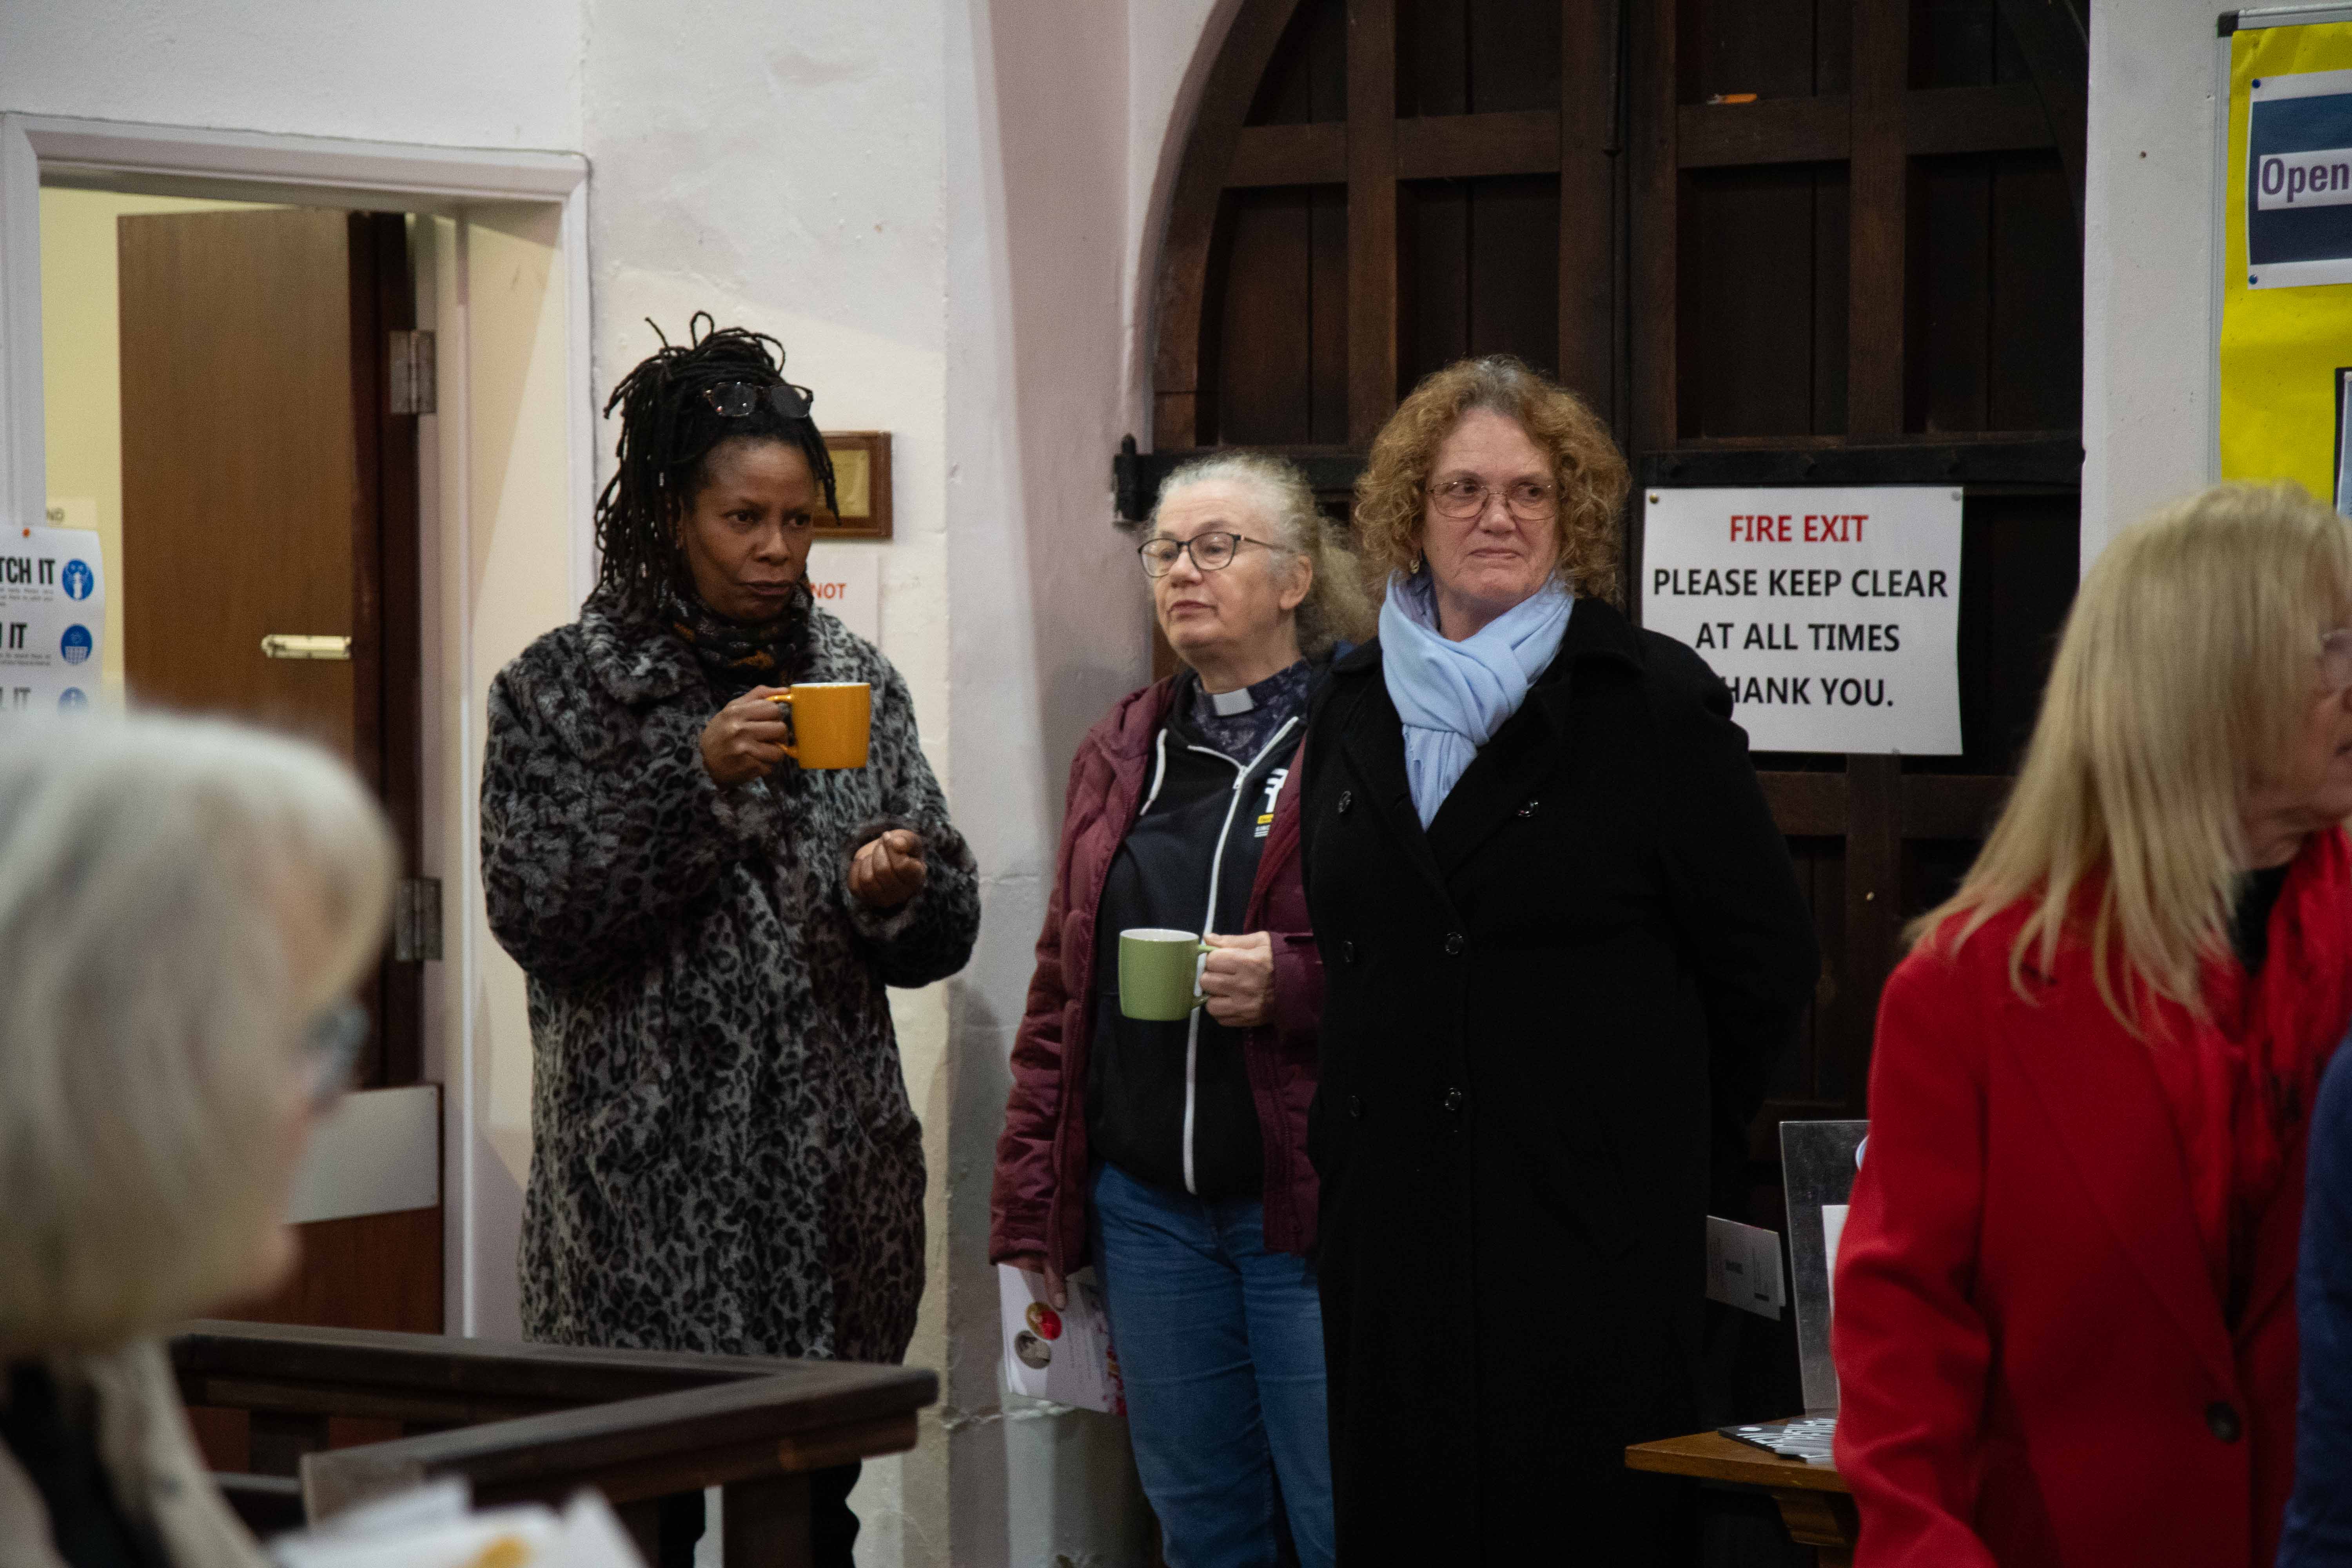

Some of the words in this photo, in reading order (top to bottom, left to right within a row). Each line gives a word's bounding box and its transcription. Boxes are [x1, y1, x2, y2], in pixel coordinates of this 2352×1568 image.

[2262, 158, 2349, 202] Open
[1730, 515, 1792, 542] FIRE
[1803, 515, 1869, 543] EXIT
[38, 558, 56, 584] IT
[1653, 568, 1758, 596] PLEASE
[1769, 569, 1842, 597] KEEP
[1851, 569, 1948, 598] CLEAR
[809, 583, 847, 599] NOT
[9, 622, 27, 649] IT
[1695, 622, 1734, 650] AT
[1743, 622, 1798, 650] ALL
[1807, 623, 1900, 652] TIMES
[1720, 676, 1811, 705] HANK
[1820, 678, 1894, 707] YOU.
